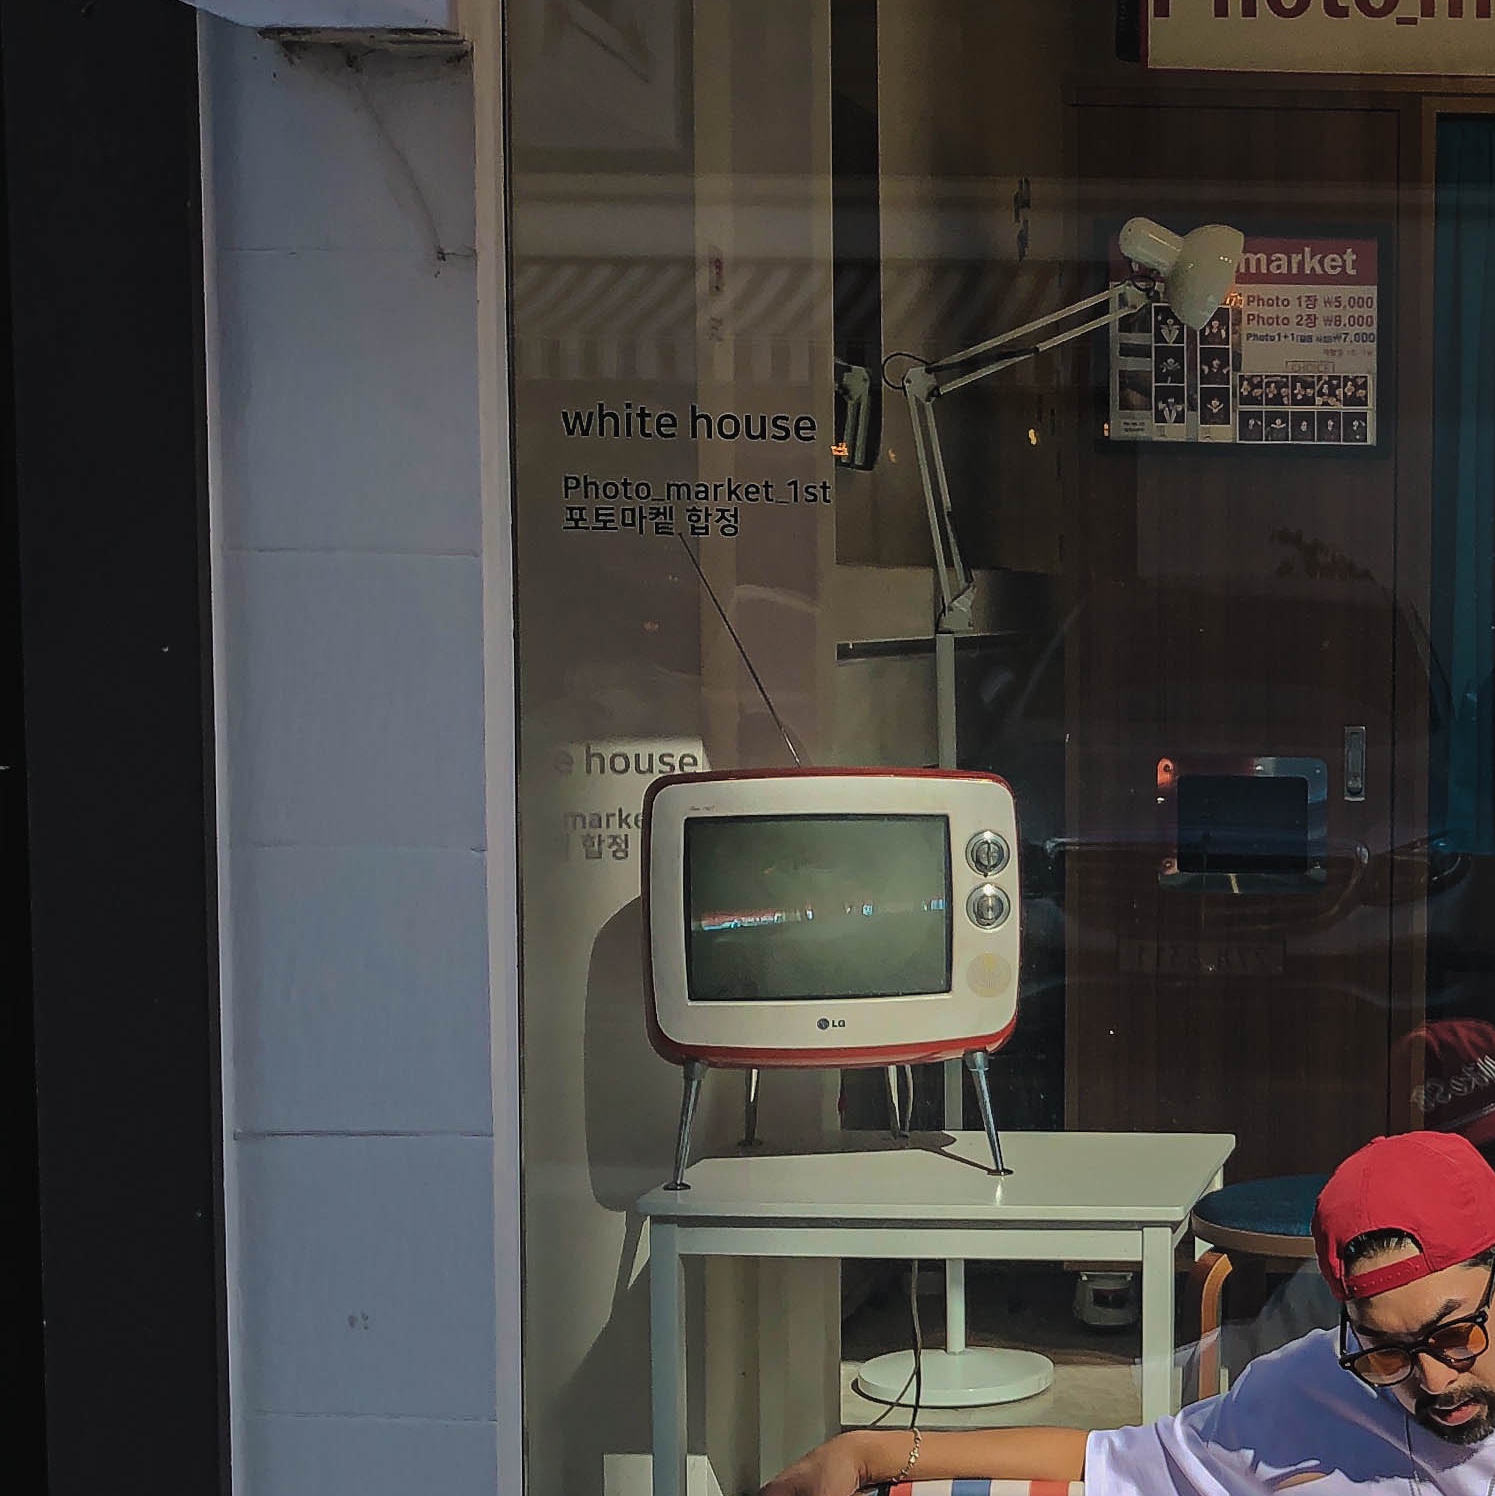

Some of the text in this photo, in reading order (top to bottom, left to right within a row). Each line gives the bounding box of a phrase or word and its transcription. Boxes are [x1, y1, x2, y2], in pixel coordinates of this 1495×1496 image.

[1246, 295, 1290, 308] Photo
[1296, 295, 1318, 310] 1장
[1246, 313, 1290, 326] Photo
[1295, 313, 1318, 328] 2장
[561, 402, 818, 442] white house
[562, 475, 832, 505] Photo_market_1st
[562, 506, 740, 537] 포토마켙 합정
[585, 743, 698, 775] house
[831, 1019, 846, 1028] LG
